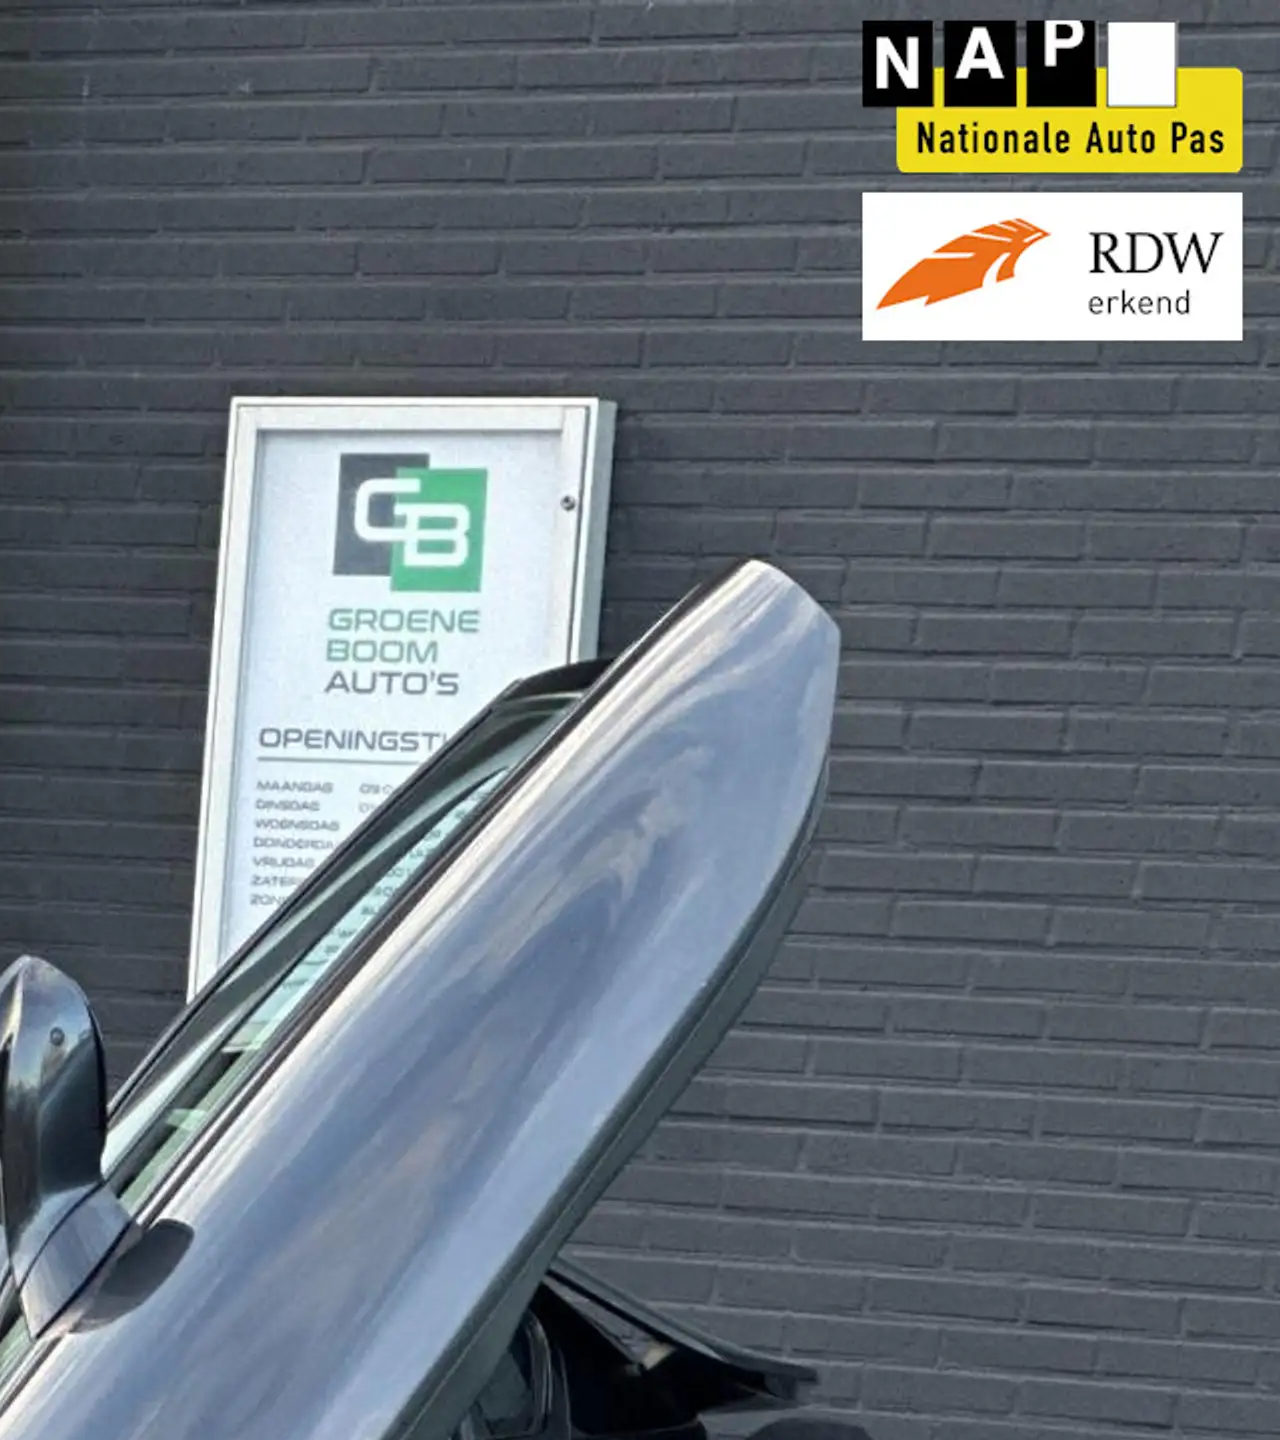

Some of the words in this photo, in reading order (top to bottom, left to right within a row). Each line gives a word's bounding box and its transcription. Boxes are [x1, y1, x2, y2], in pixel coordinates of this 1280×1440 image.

[327, 607, 481, 634] GROENE
[325, 638, 439, 664] BOOM
[323, 669, 460, 696] AUTO'S
